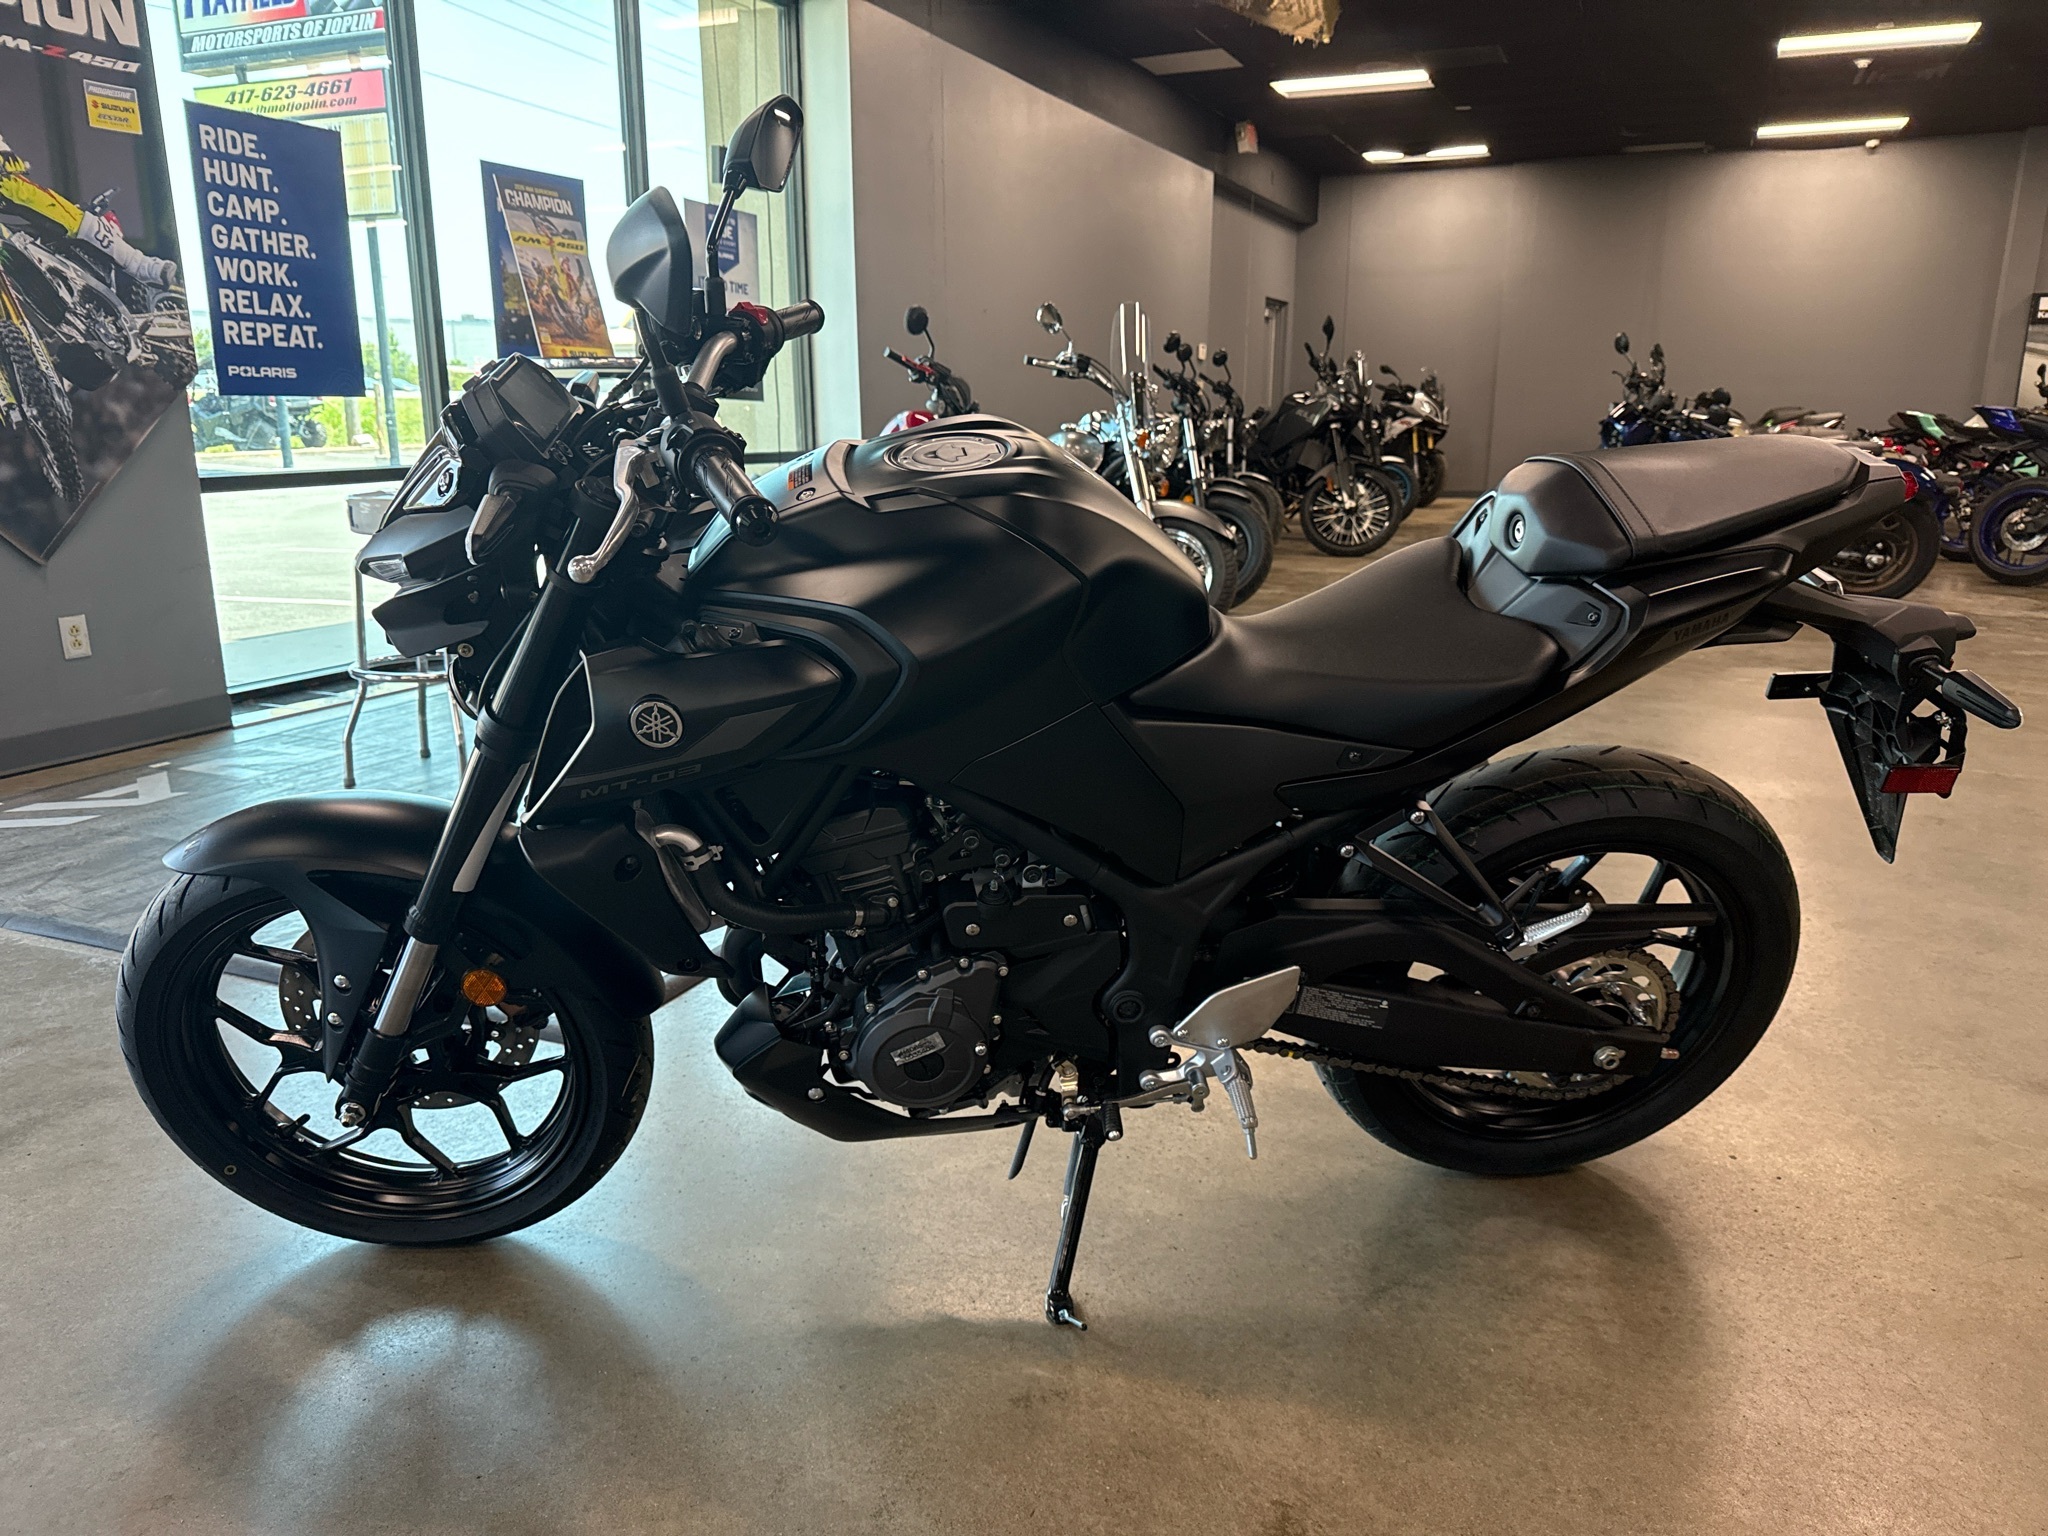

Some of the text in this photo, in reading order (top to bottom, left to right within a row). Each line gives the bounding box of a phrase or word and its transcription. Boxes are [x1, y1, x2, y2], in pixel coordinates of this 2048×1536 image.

[190, 11, 377, 53] MOTORSPORTS OF JOPLIN
[224, 77, 353, 105] 417-623-4661
[100, 102, 136, 114] SUZUKI
[199, 123, 267, 160] RIDE.
[202, 157, 279, 194] HUNT.
[207, 190, 288, 226] CAMP.
[504, 188, 574, 216] CHAMPION
[211, 223, 317, 260] GATHER.
[214, 255, 298, 288] WORK.
[218, 287, 312, 319] RELAX.
[728, 280, 750, 296] TIME
[222, 319, 324, 350] REPEAT.
[227, 365, 298, 379] POLARIS
[580, 763, 701, 800] MT-03
